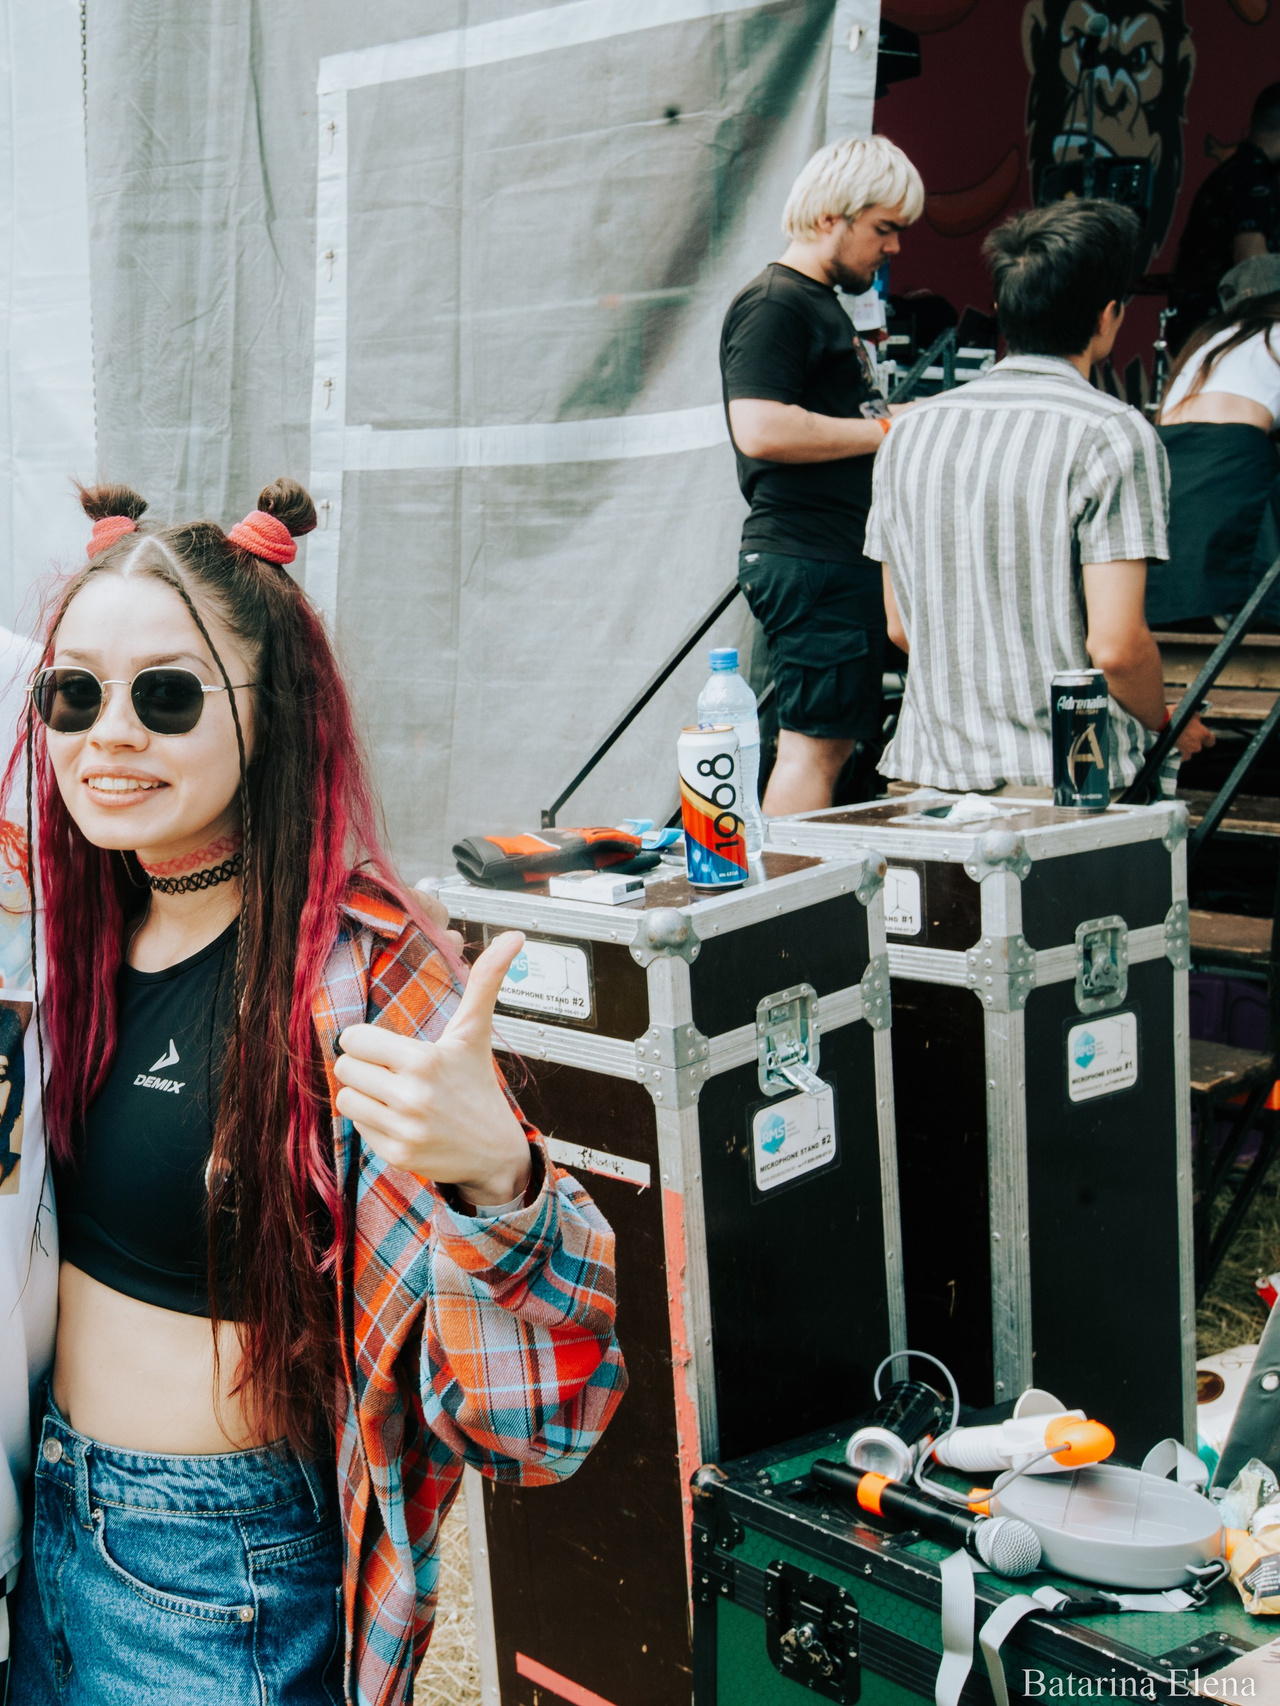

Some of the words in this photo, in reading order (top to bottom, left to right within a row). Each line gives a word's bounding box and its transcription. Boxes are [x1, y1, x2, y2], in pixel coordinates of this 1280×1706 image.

[1056, 695, 1108, 713] Adrenalin
[696, 752, 740, 852] 1968
[901, 914, 913, 924] #1
[510, 959, 527, 972] MS
[501, 986, 544, 999] MICROPHONE
[546, 994, 569, 1005] STAND
[572, 997, 585, 1008] #2
[133, 1074, 186, 1094] DEMIX
[760, 1152, 799, 1173] MICROPHONE
[800, 1142, 820, 1156] STAND
[821, 1134, 832, 1147] #2
